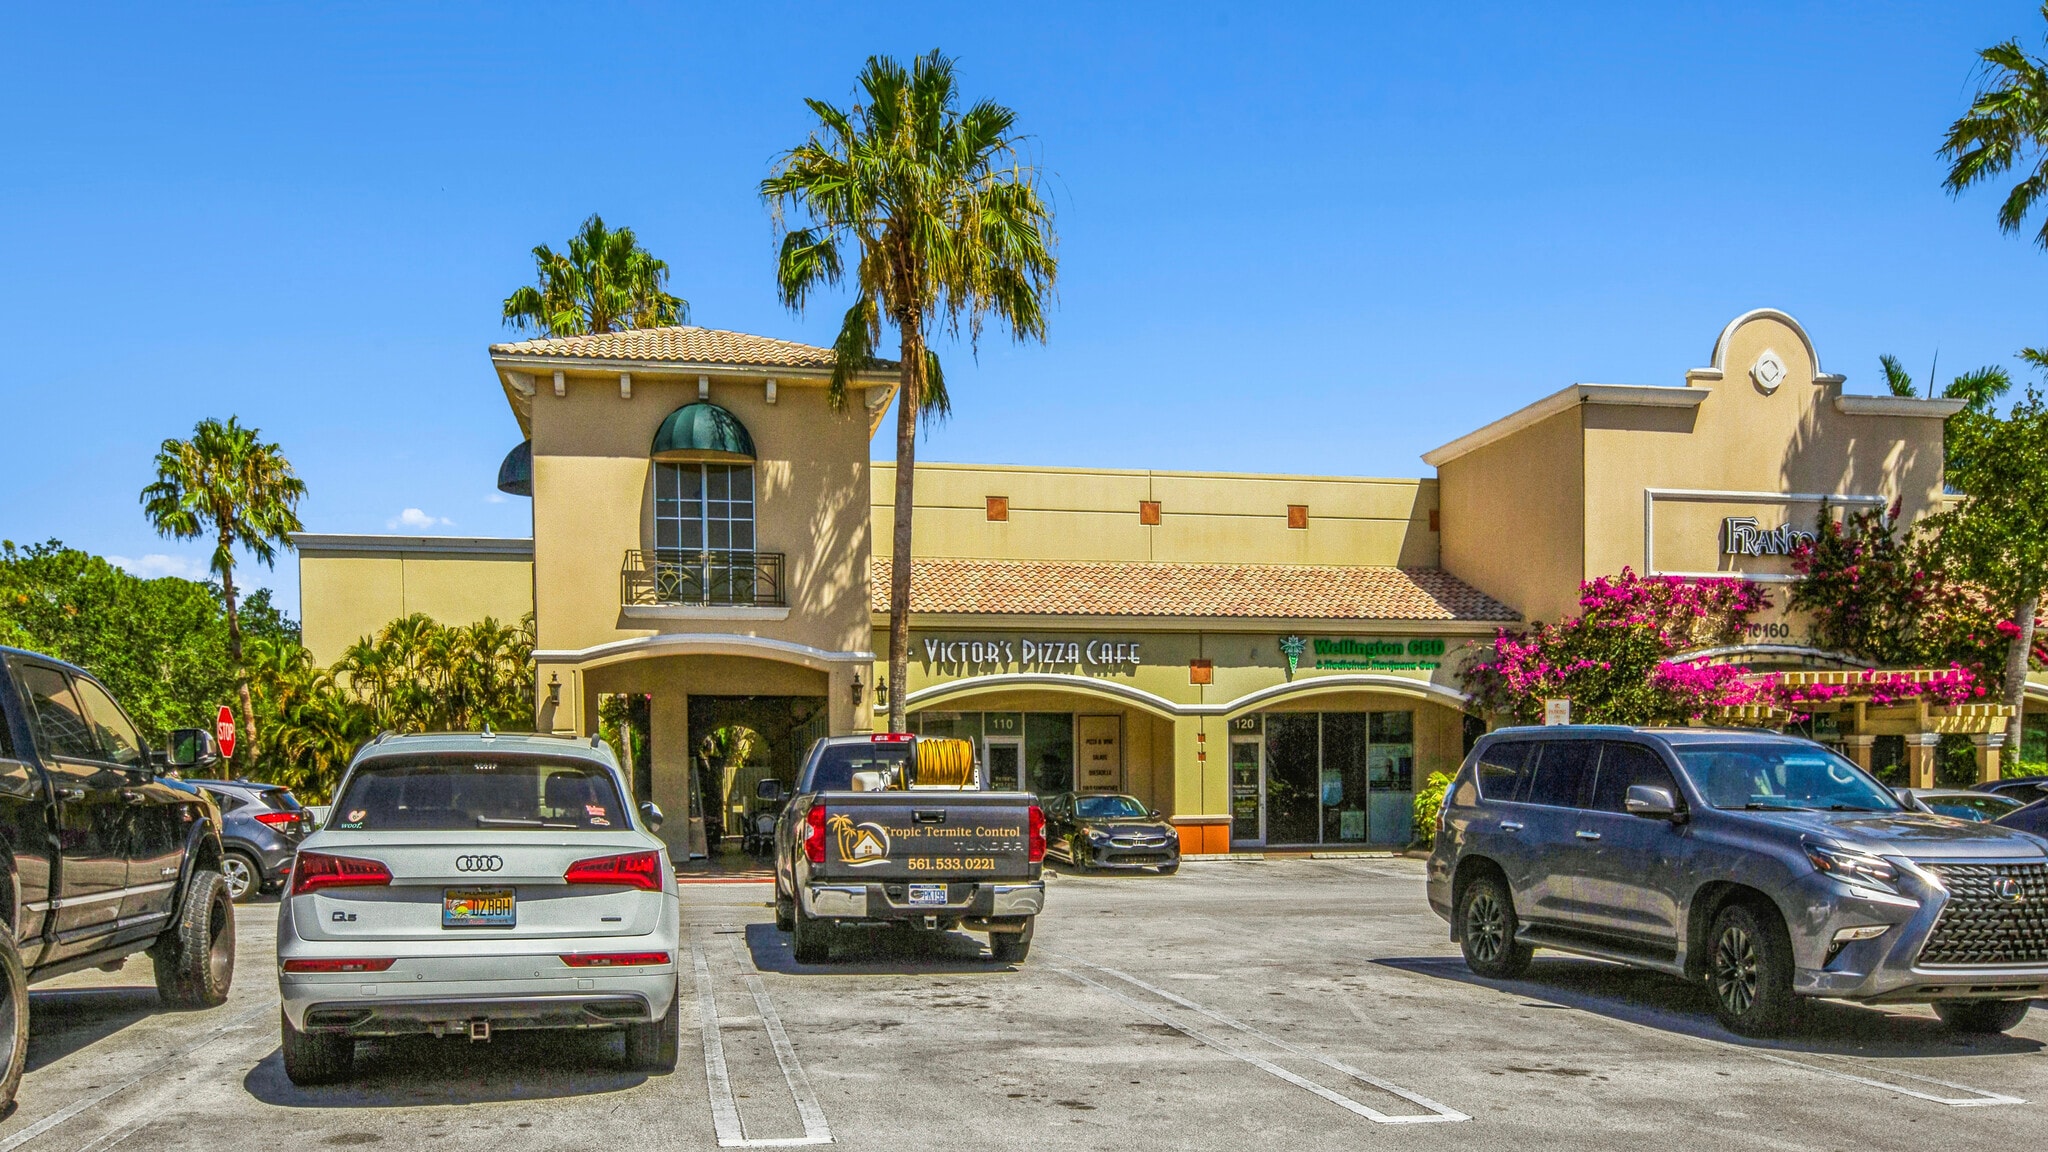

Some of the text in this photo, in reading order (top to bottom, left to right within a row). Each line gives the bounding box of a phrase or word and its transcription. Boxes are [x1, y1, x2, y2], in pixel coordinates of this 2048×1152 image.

[1747, 622, 1790, 639] 10160
[924, 638, 1141, 665] VICTOR'S PIZZA CAFE
[1314, 639, 1445, 659] Wellington CBD
[993, 719, 1014, 730] 110
[1234, 718, 1255, 730] 120
[218, 721, 234, 741] STOP
[884, 826, 1021, 840] Tropic Termite Control
[954, 841, 1024, 851] TUNDRA
[908, 858, 996, 870] 561.533.0221
[331, 911, 357, 922] Q5
